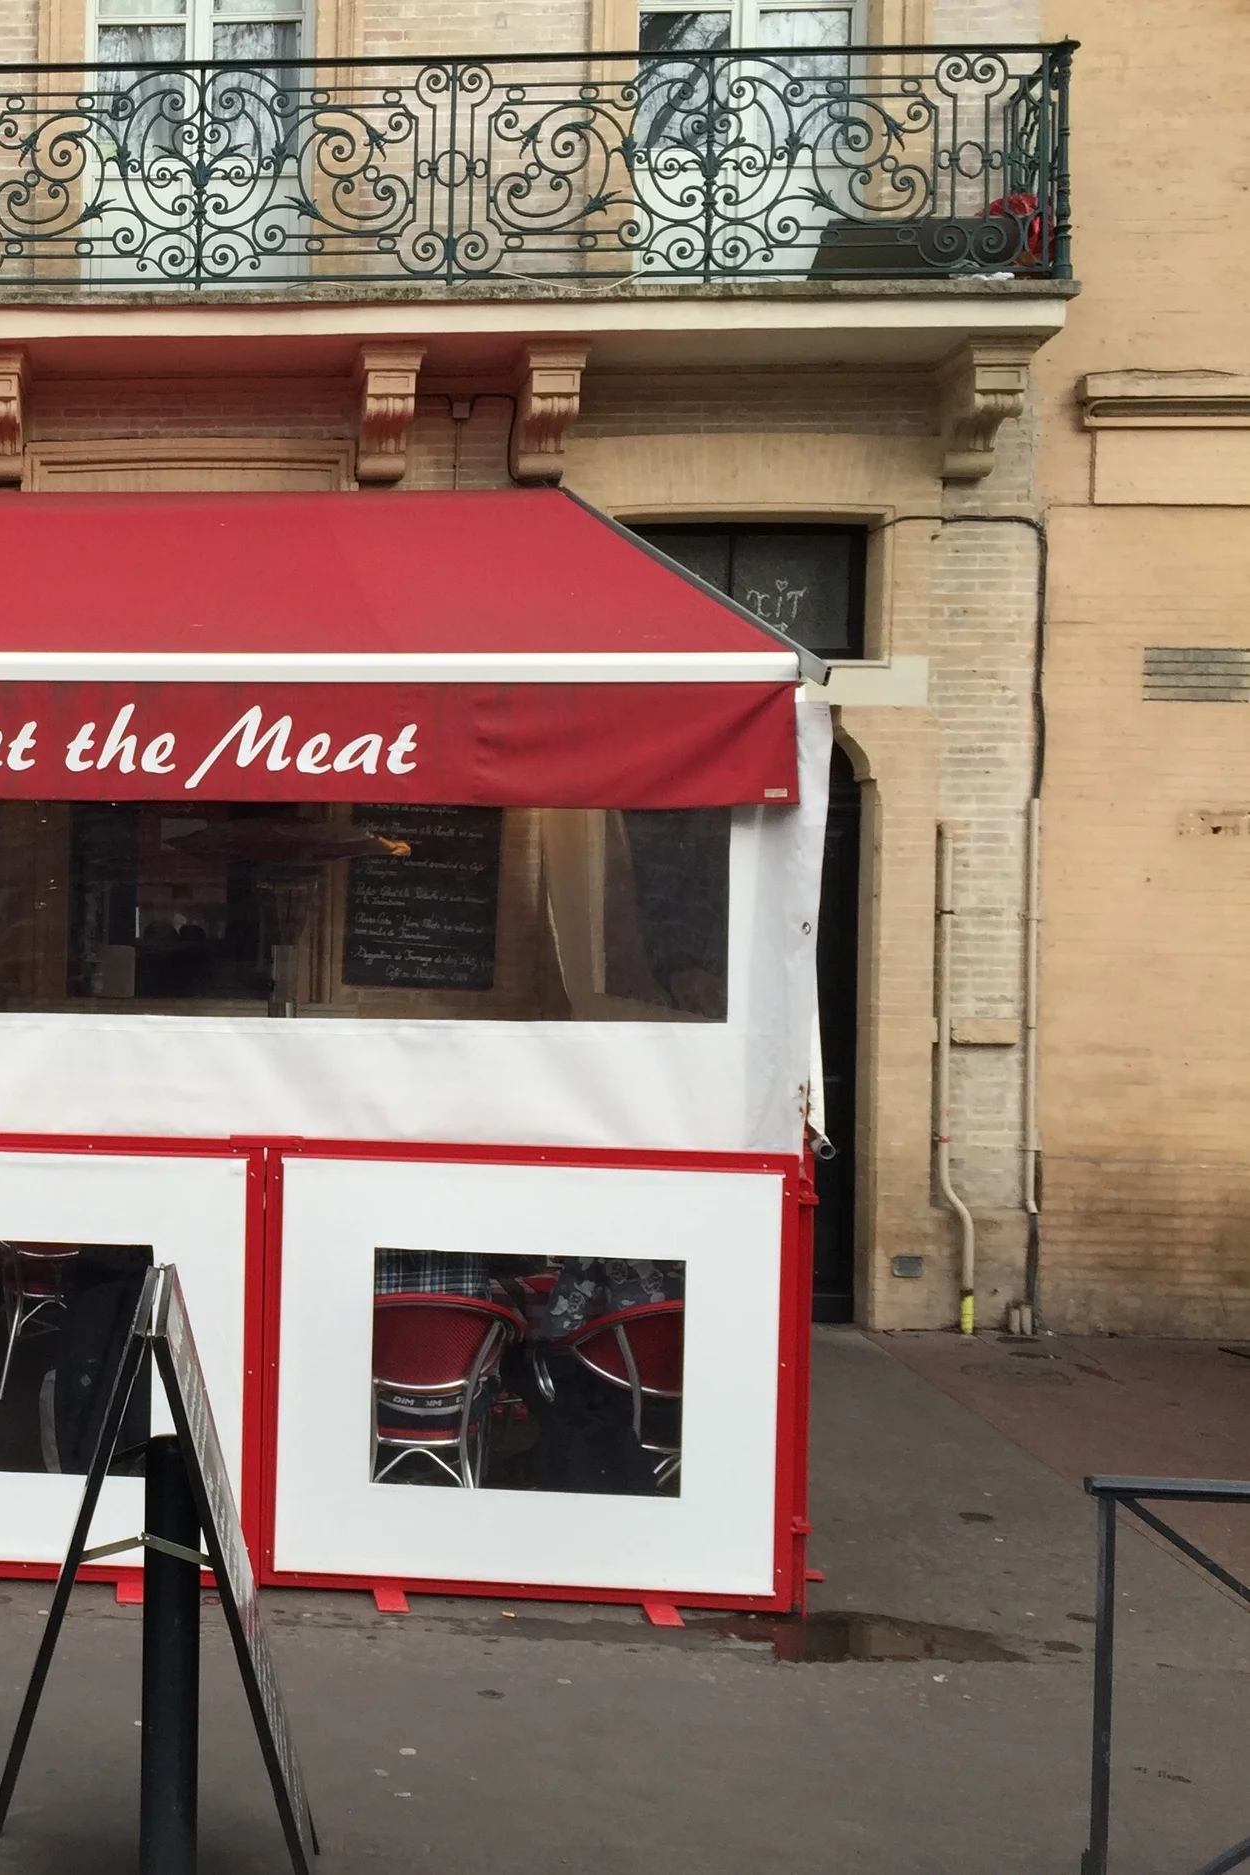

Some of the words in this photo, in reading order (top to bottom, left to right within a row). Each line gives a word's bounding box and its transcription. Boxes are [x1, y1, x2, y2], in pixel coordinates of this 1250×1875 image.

[65, 703, 176, 775] the
[184, 704, 418, 790] Meat
[392, 1395, 415, 1406] DIM
